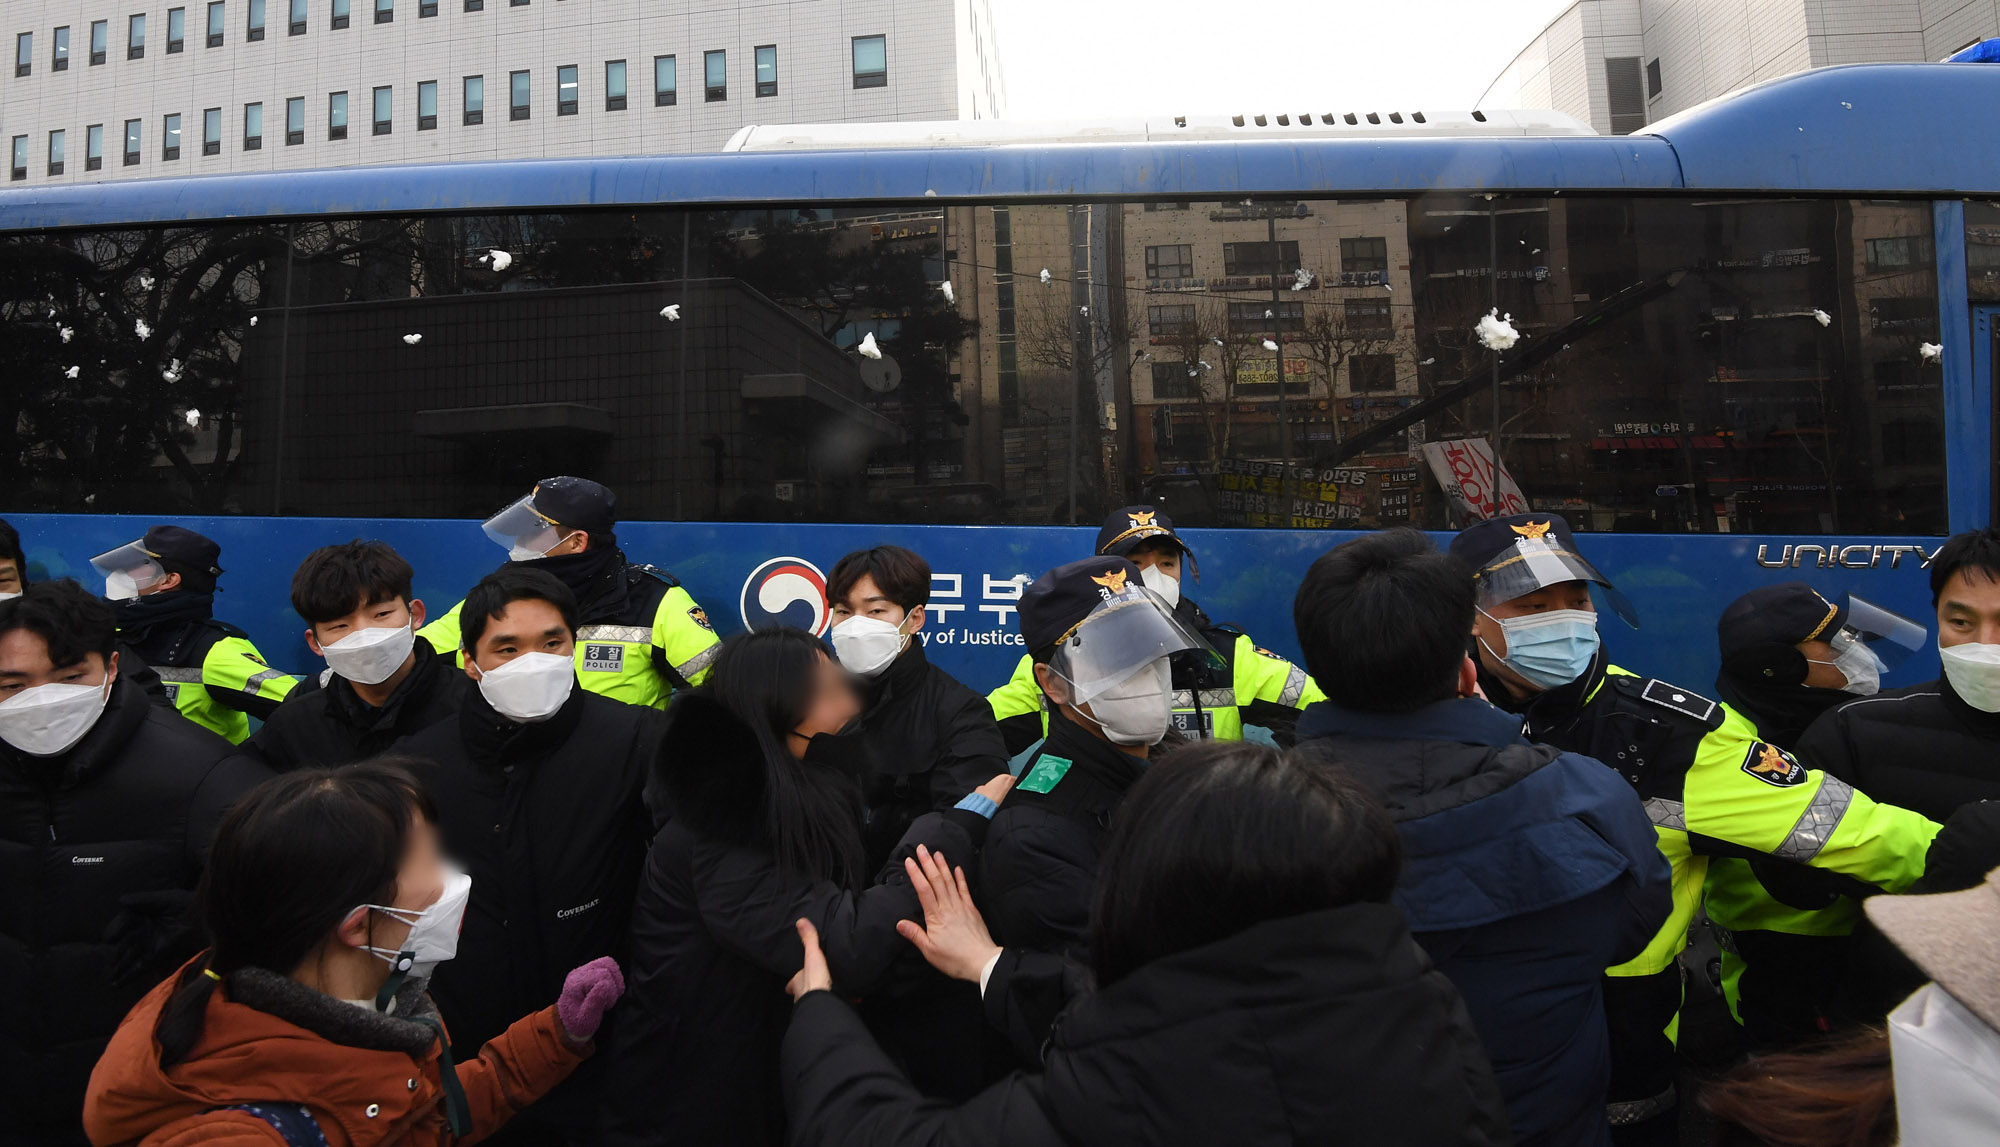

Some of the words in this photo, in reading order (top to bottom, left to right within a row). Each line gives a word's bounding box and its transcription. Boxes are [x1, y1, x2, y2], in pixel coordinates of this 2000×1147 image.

[1757, 544, 1945, 568] UNICITY
[924, 573, 1024, 625] 무부
[936, 629, 956, 645] of
[960, 628, 1025, 646] Justice
[588, 646, 620, 660] 경찰
[586, 661, 619, 669] POLICE
[1785, 764, 1800, 783] POLICE
